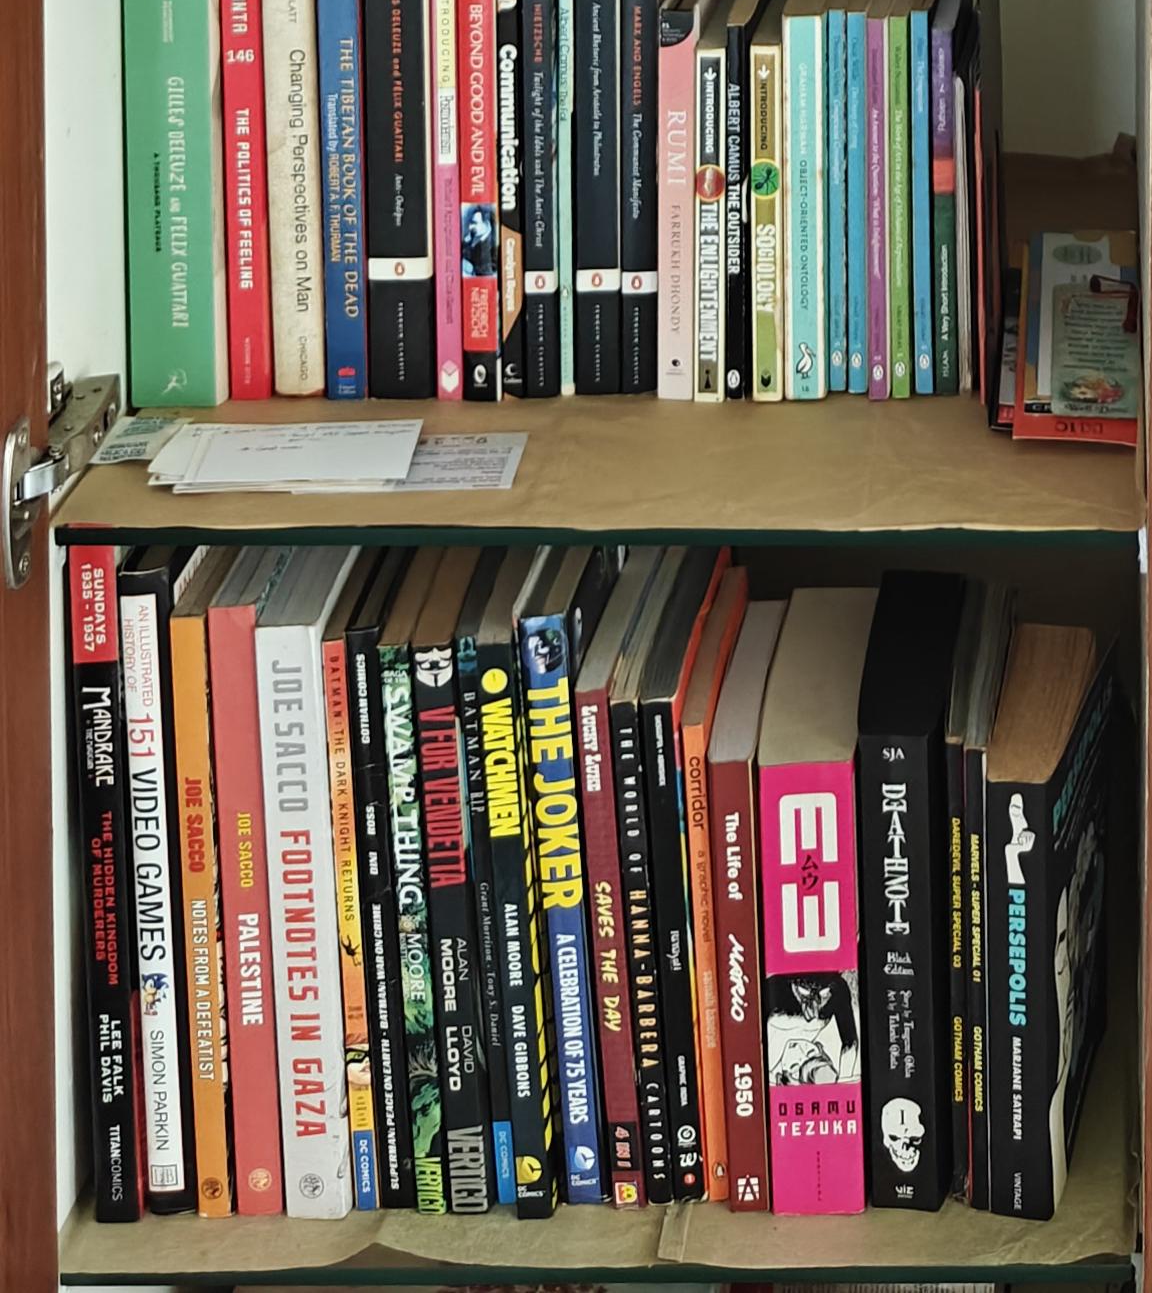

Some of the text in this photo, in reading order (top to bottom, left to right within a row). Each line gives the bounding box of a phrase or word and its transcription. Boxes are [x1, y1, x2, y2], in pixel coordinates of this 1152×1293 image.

[469, 4, 484, 195] BEYOND GOOD AND EVIL
[500, 44, 518, 210] Communication
[666, 110, 686, 186] RUMI
[287, 48, 311, 312] Changing Perspectives on Man
[755, 224, 776, 313] SOCIOLOGY
[128, 712, 165, 961] 151 VIDEO GAMES
[482, 697, 520, 837] WATCHMEN
[527, 678, 583, 909] THE JOKER
[686, 756, 706, 830] corridor
[237, 913, 262, 1026] PALESTINE
[280, 829, 326, 1138] FOOTNOTES IN GAZA
[1008, 889, 1026, 1139] PERSEPOLIS MARJANE SATRAPI
[734, 1062, 754, 1117] 1950
[778, 1120, 857, 1135] TEZUKA
